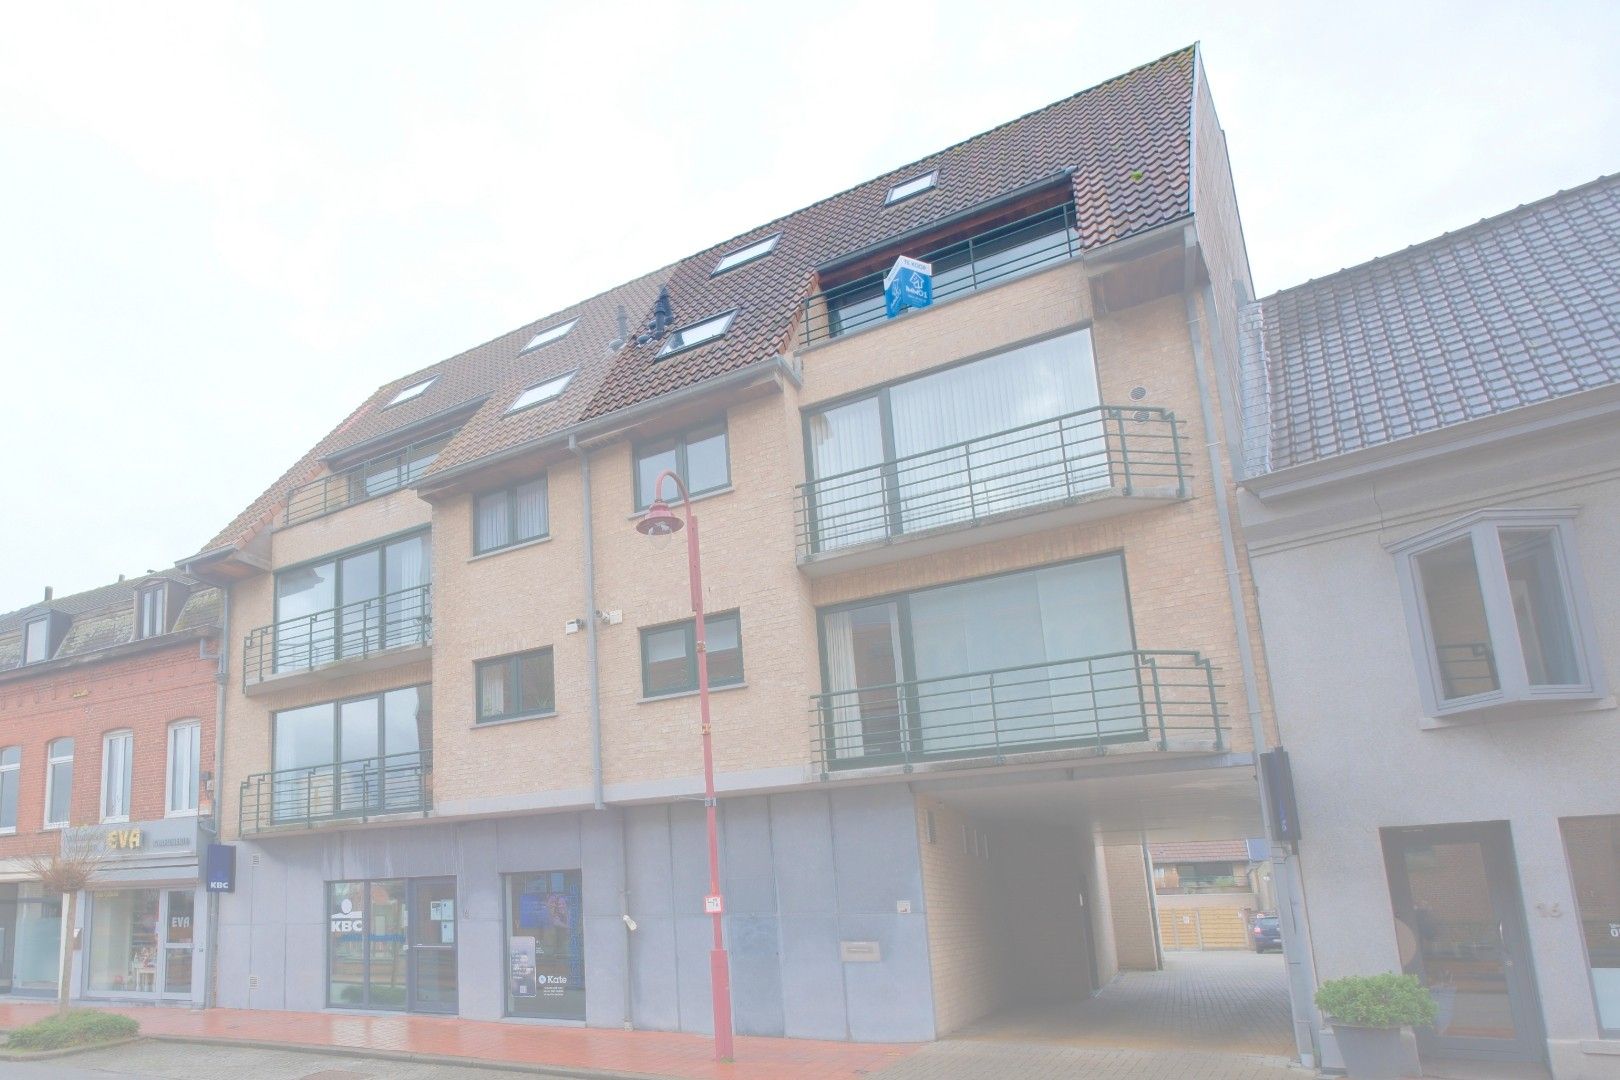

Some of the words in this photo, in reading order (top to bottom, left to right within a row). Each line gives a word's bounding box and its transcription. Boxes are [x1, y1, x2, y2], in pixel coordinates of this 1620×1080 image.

[107, 828, 141, 849] EVA
[210, 881, 229, 889] KBC
[171, 916, 191, 928] EVA
[331, 920, 363, 932] KBC
[547, 975, 567, 984] Kate
